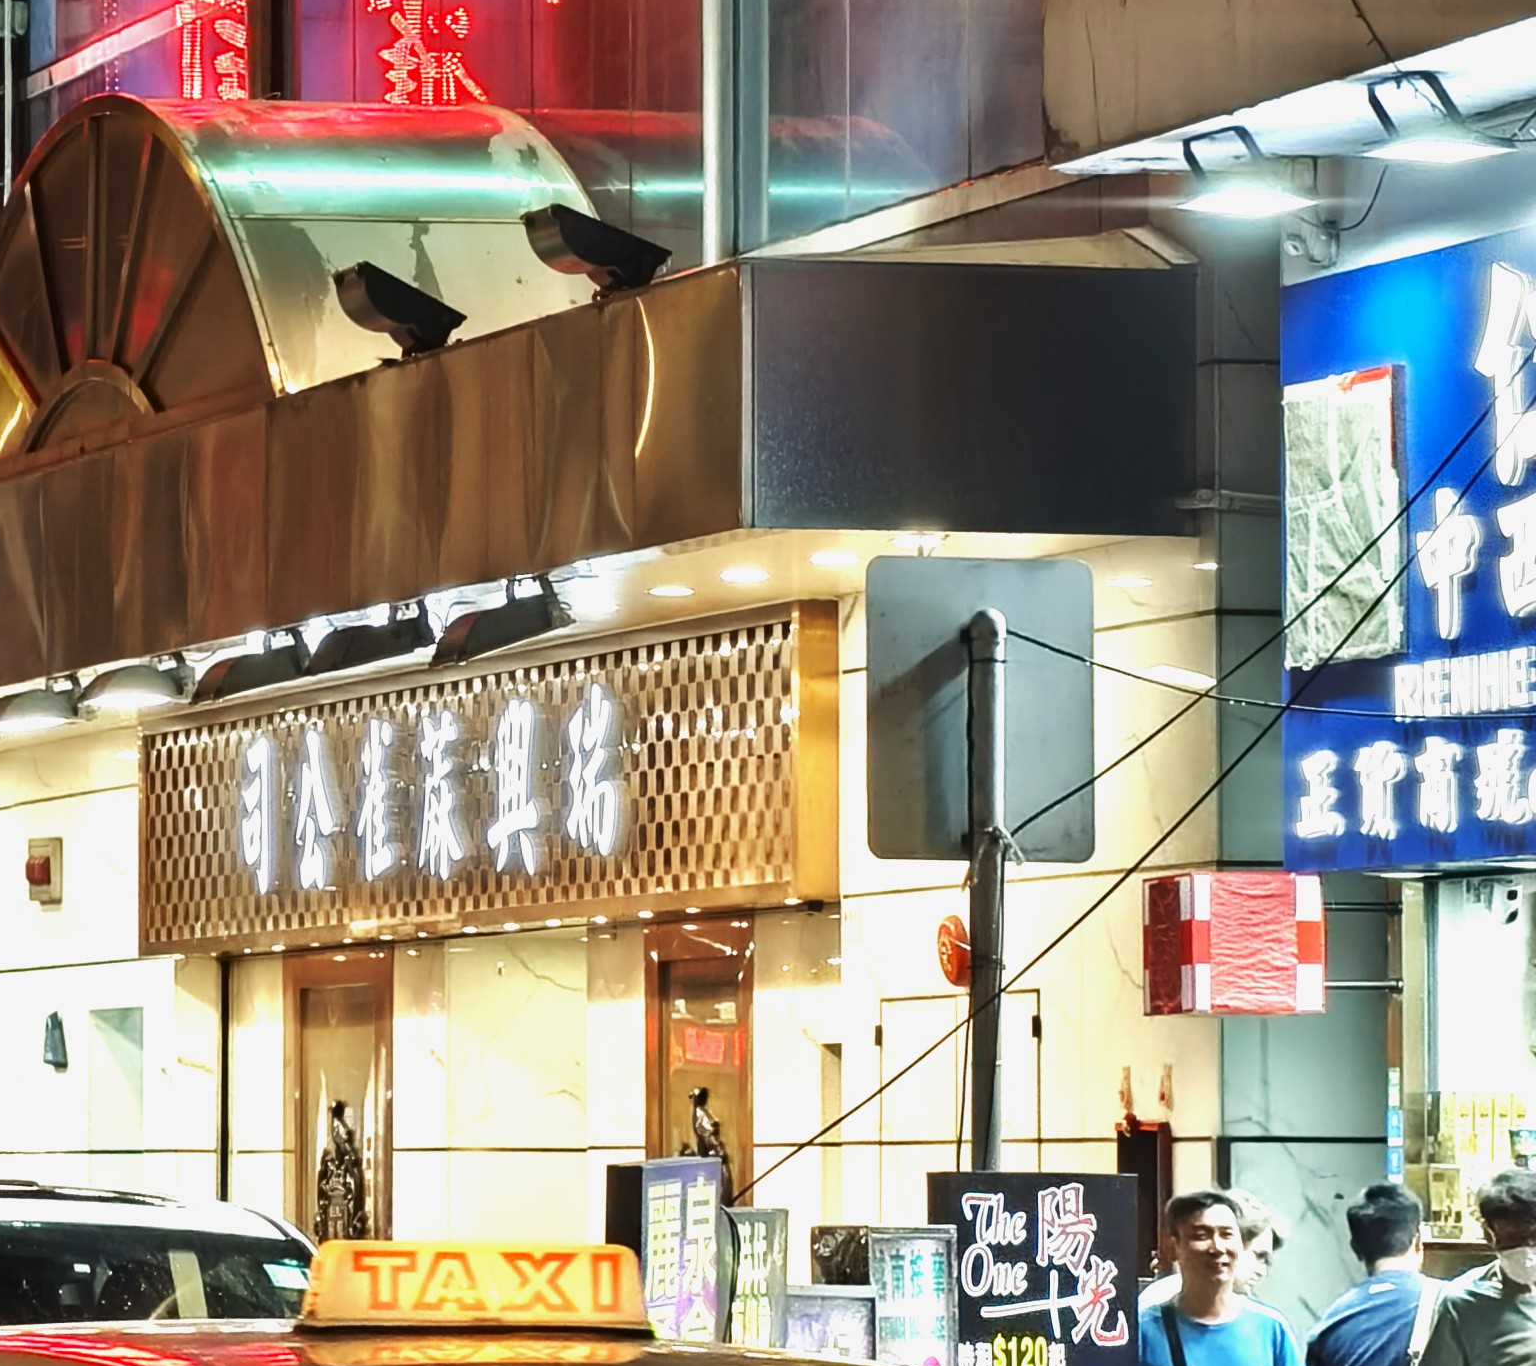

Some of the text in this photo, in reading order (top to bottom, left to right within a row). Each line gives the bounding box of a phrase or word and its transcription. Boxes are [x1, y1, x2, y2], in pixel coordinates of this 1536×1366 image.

[962, 1192, 1027, 1246] The
[352, 1249, 623, 1314] TAXI
[960, 1243, 1028, 1298] One
[1035, 1182, 1130, 1347] 陽光
